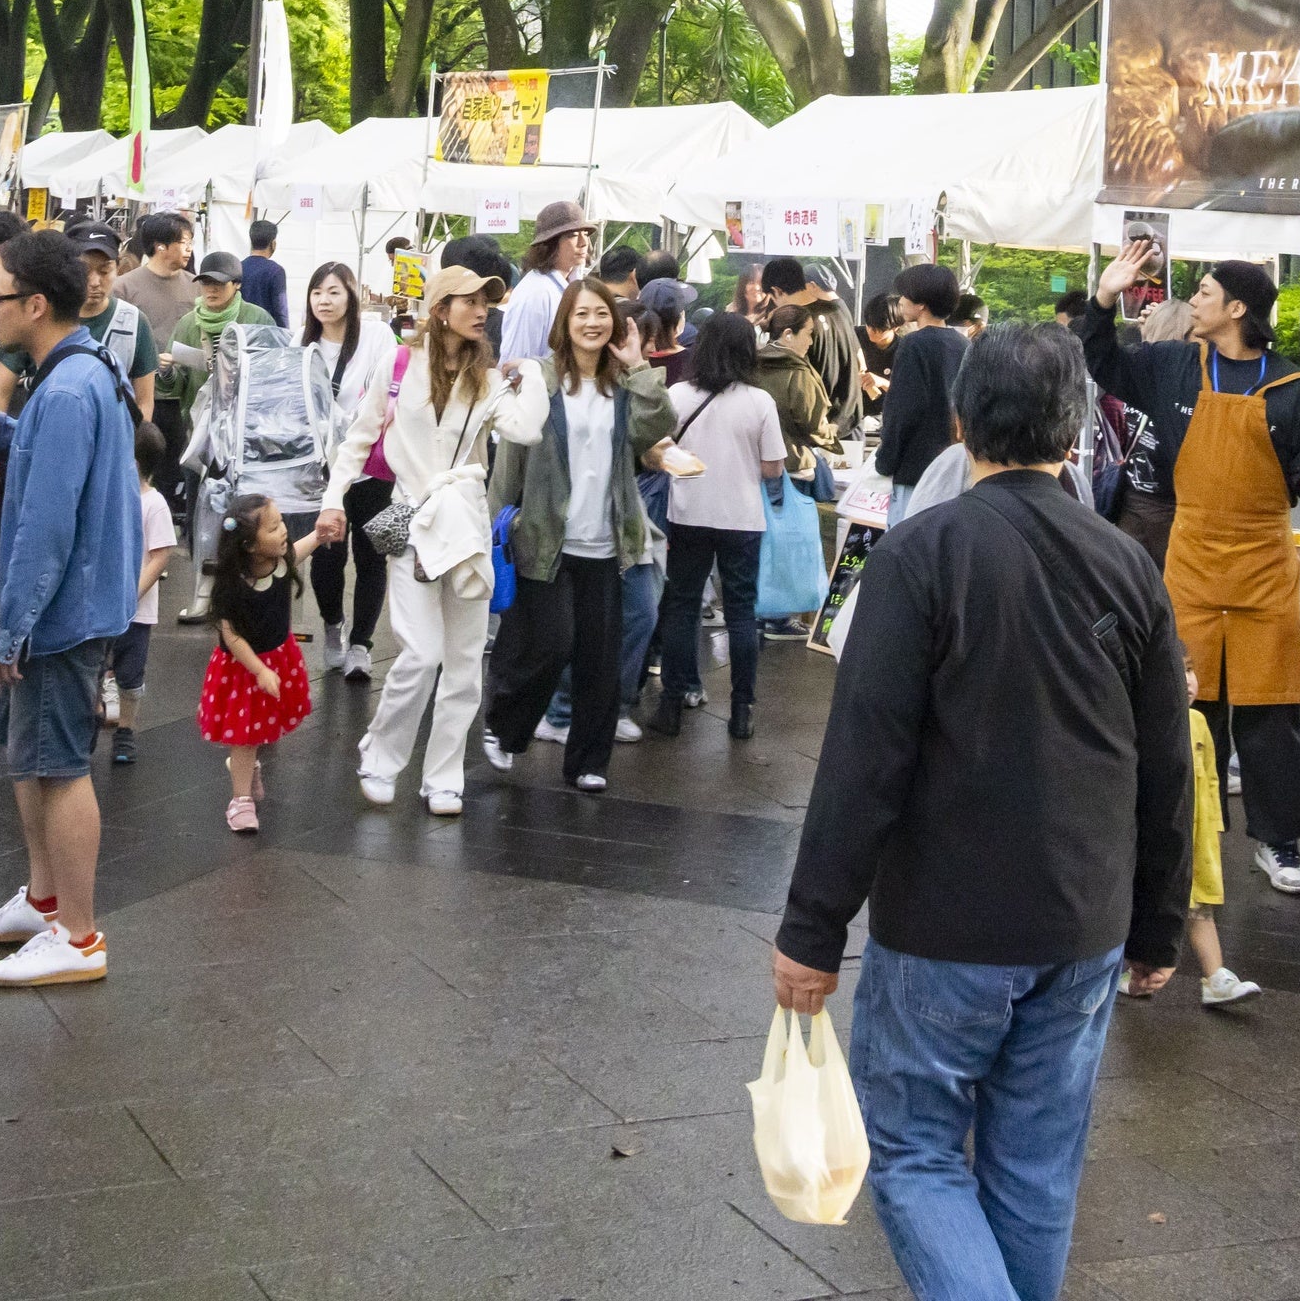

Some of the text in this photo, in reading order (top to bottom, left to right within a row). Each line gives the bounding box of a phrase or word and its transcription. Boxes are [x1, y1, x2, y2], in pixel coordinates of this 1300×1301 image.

[462, 96, 543, 121] 自家製ソーセージ
[1258, 176, 1285, 190] THE
